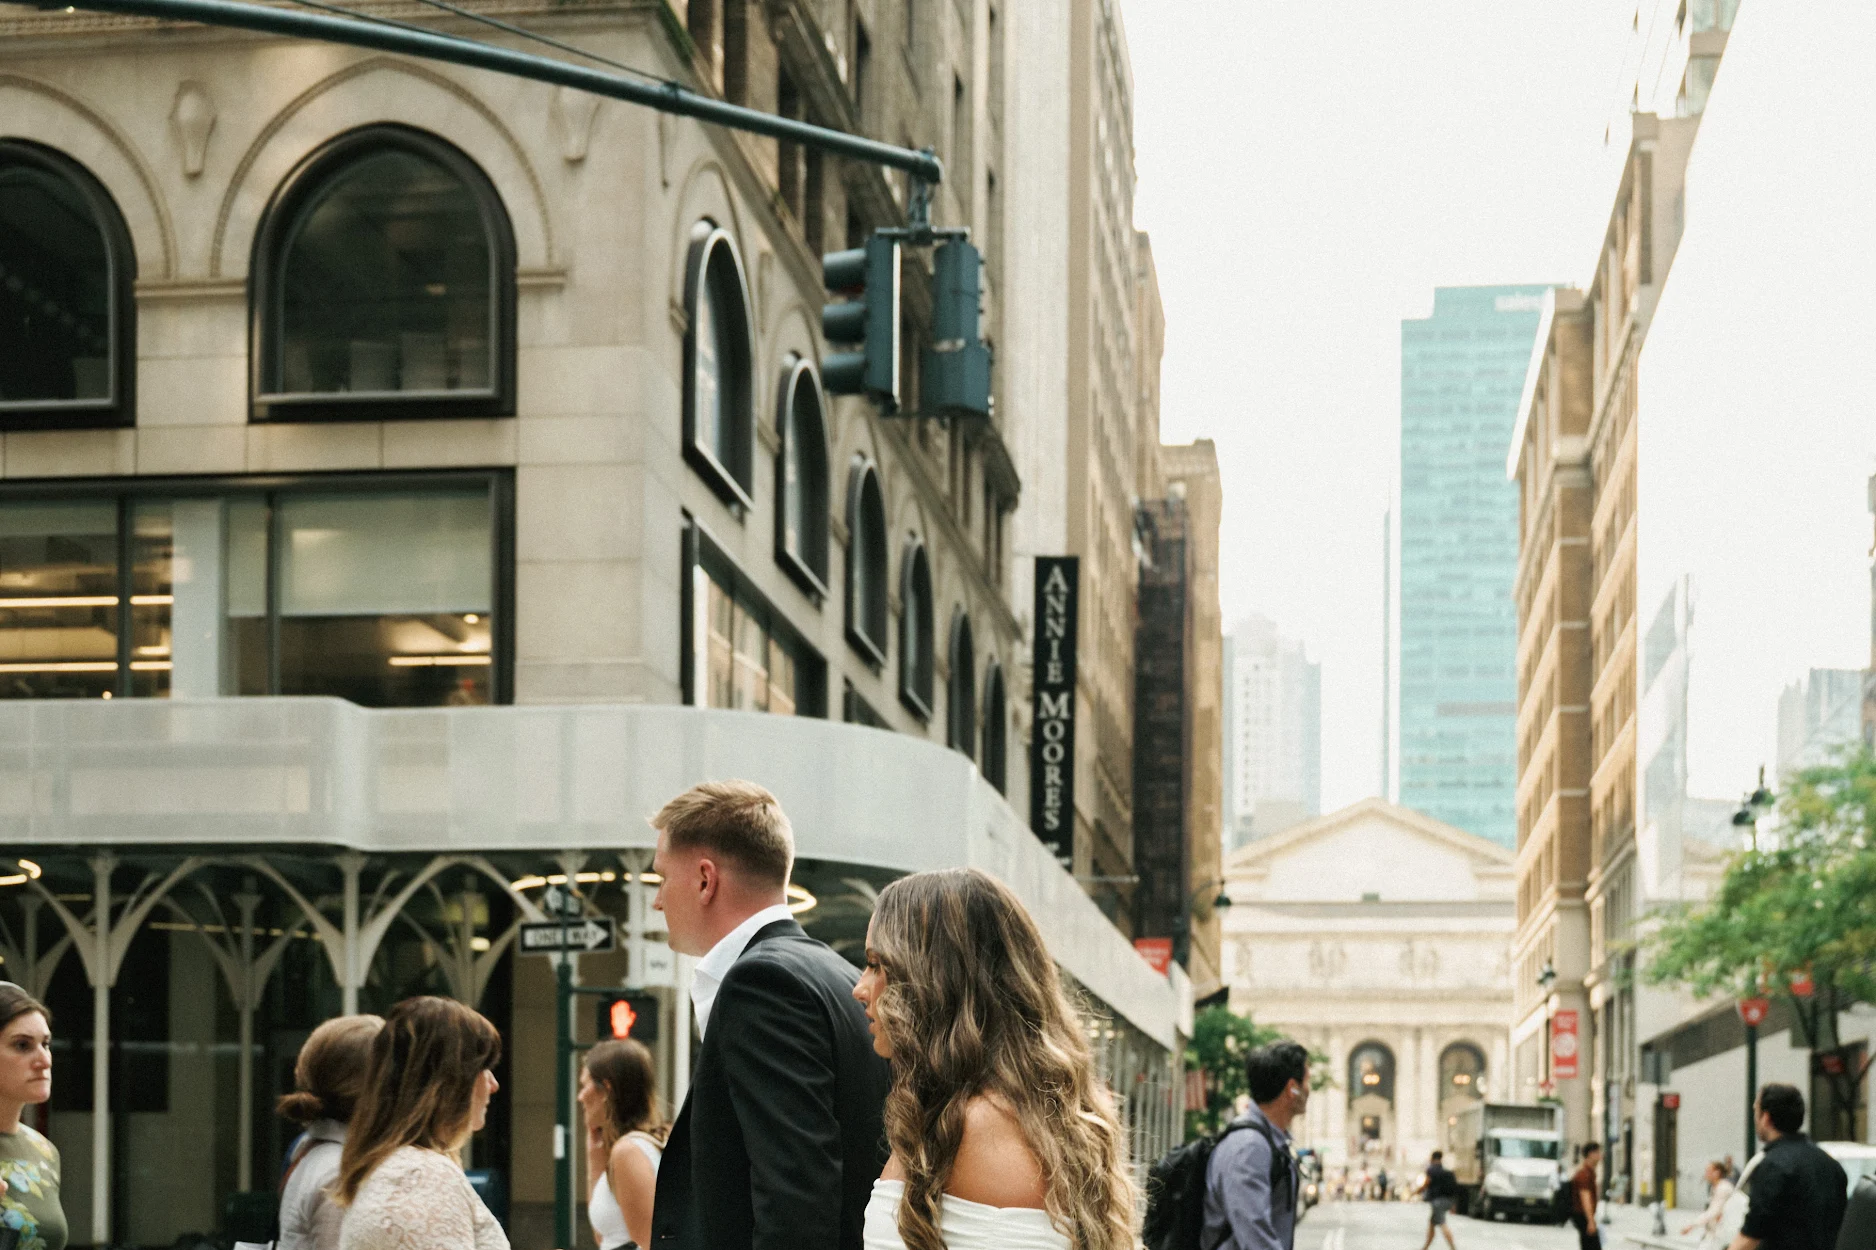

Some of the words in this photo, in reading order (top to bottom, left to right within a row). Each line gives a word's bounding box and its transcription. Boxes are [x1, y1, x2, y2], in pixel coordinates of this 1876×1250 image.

[1043, 564, 1069, 684] ANNIE
[1038, 691, 1070, 831] MOORES
[533, 930, 557, 946] ONE
[571, 929, 598, 943] WAY
